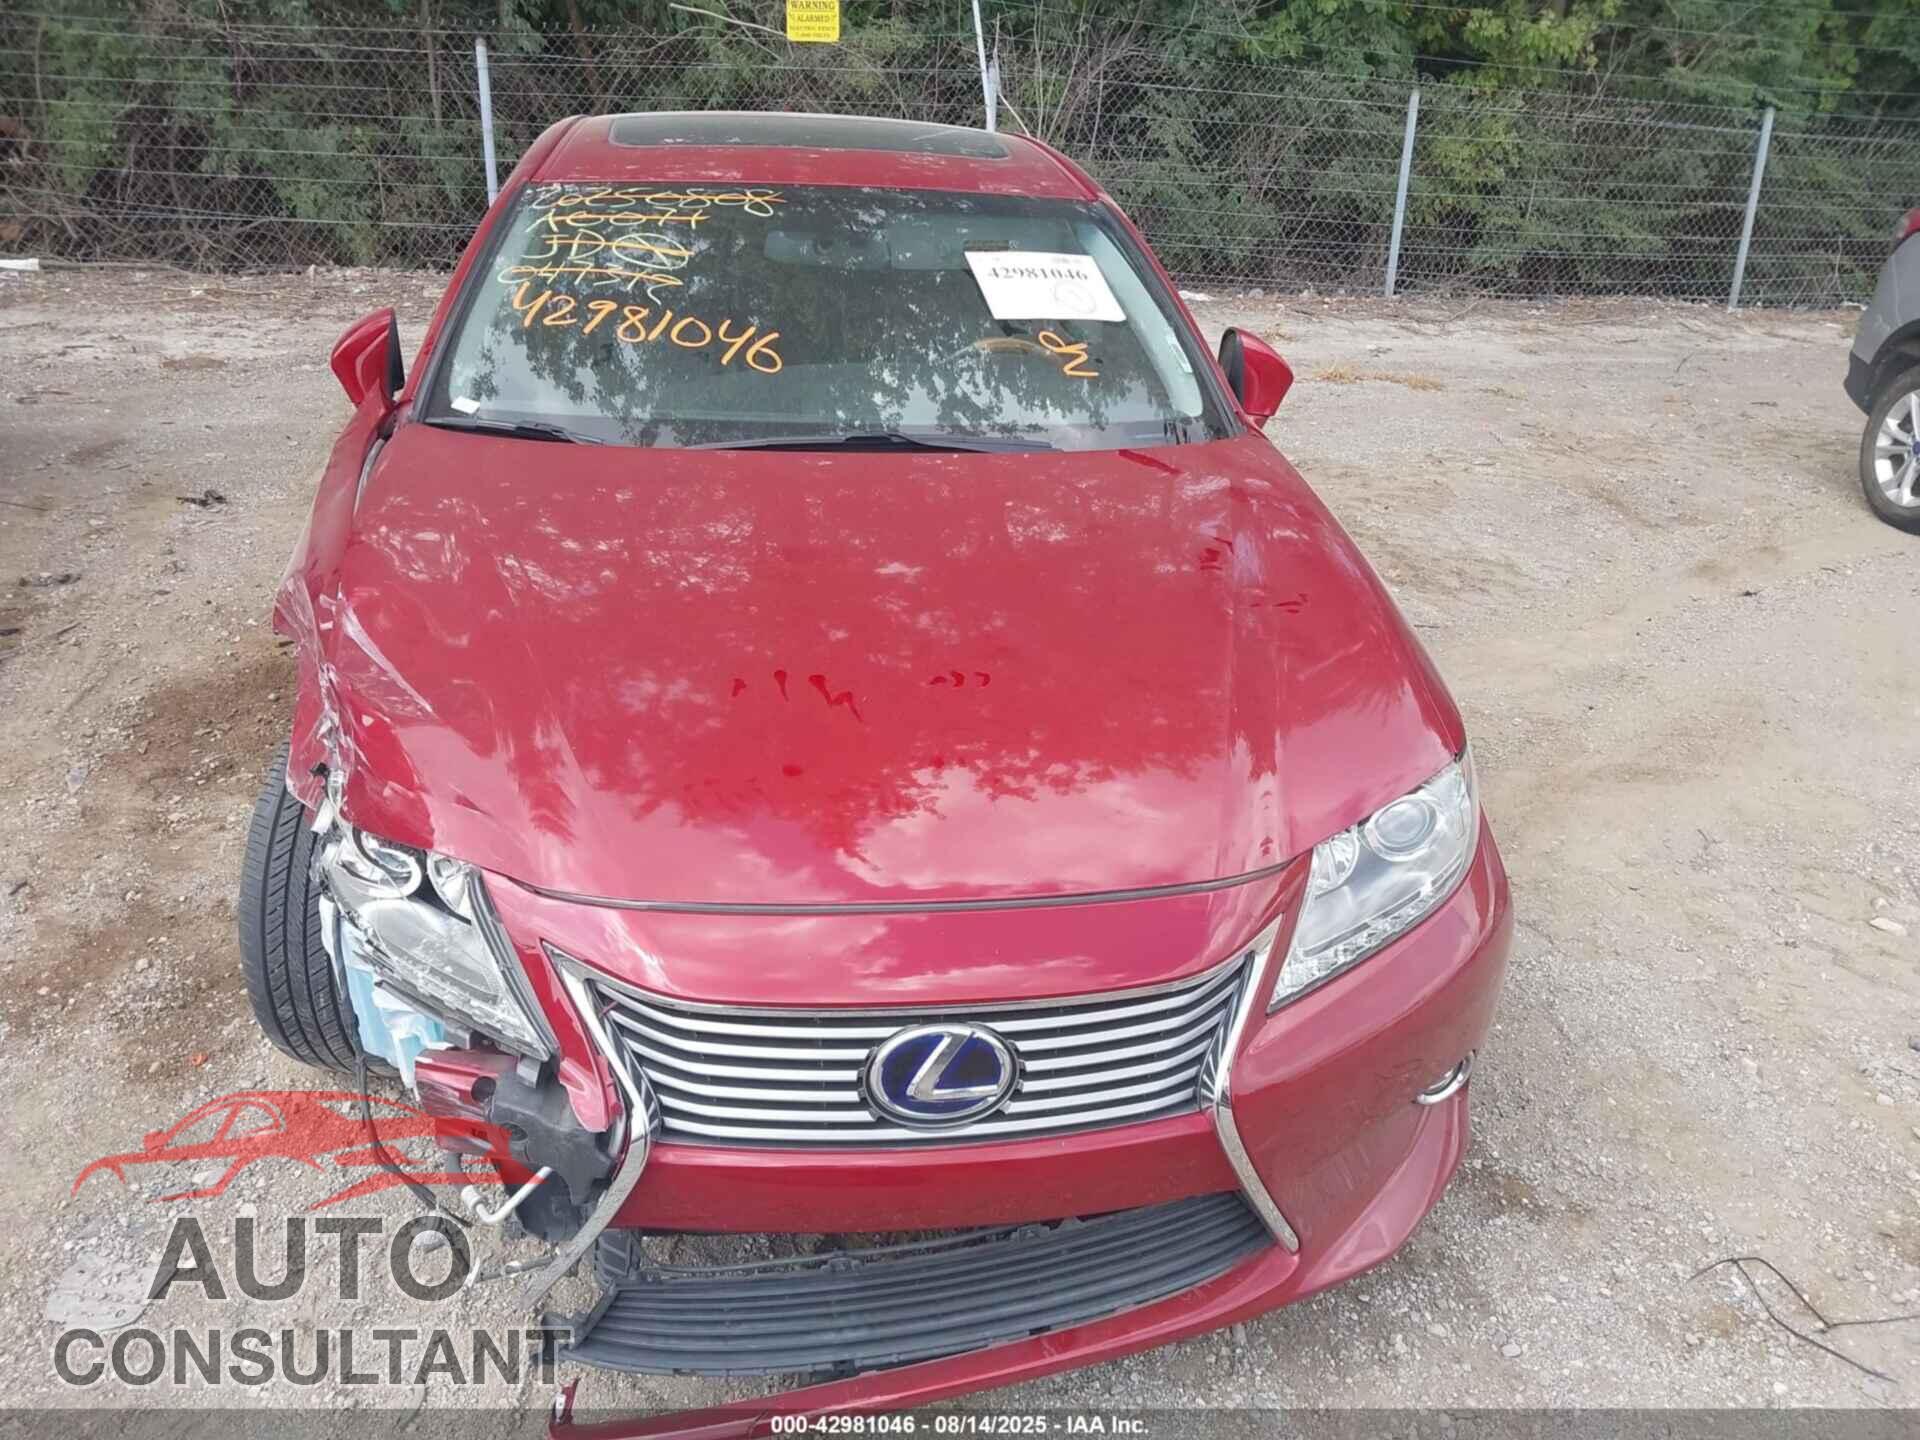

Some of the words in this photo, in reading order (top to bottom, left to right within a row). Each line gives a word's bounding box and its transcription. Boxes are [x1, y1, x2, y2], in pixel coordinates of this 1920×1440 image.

[791, 1, 835, 9] WARNING
[987, 266, 1089, 281] 42981046
[512, 281, 783, 374] 42981046
